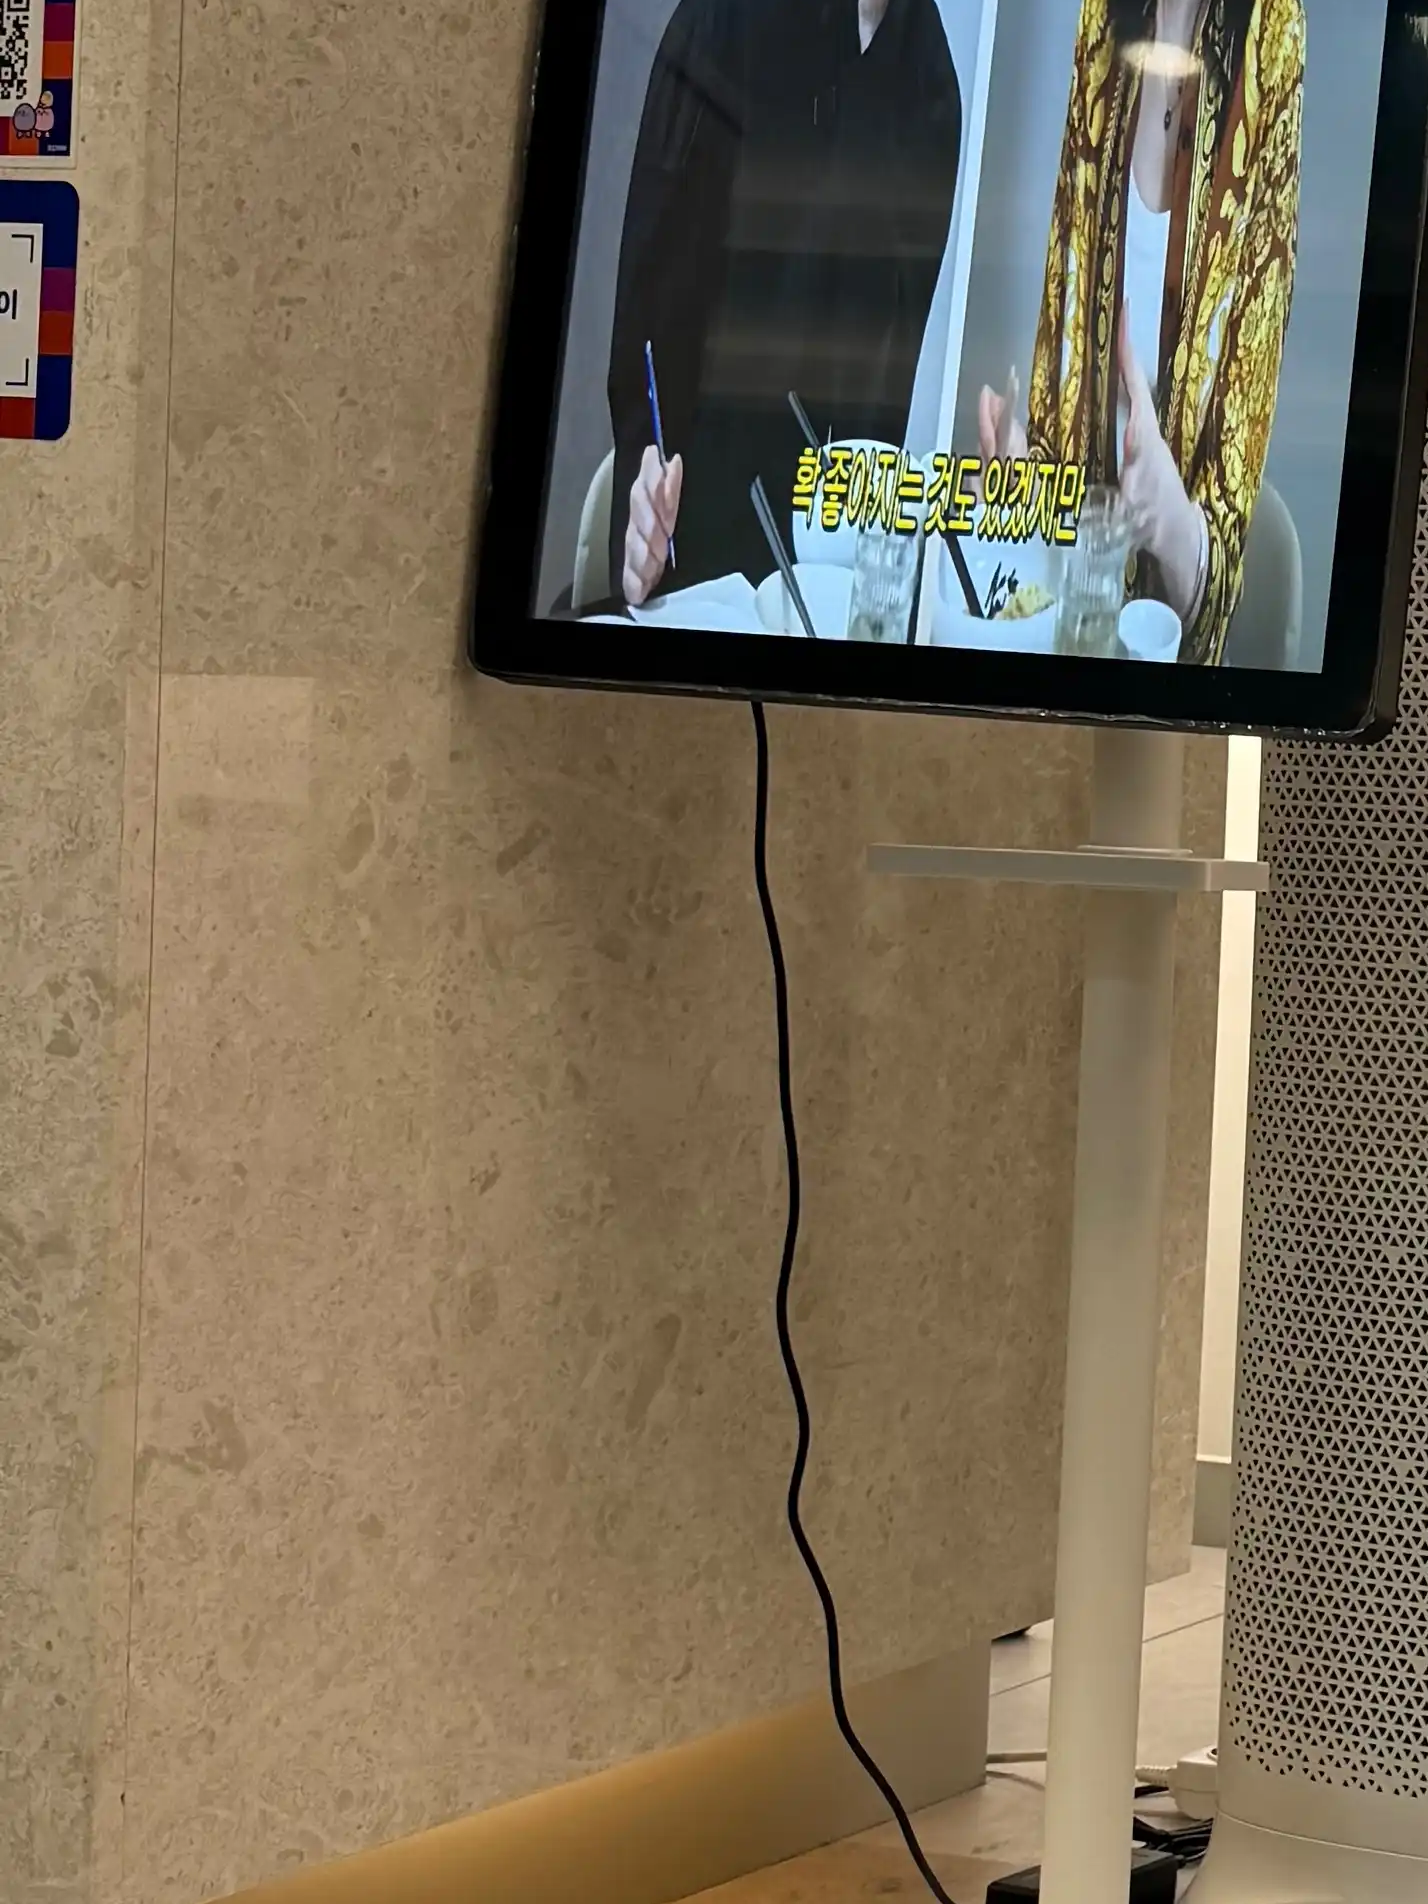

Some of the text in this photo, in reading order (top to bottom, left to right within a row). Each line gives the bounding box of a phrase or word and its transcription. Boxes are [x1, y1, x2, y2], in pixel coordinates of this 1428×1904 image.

[792, 446, 1087, 546] 확 좋아지는 것도 있겠지만
